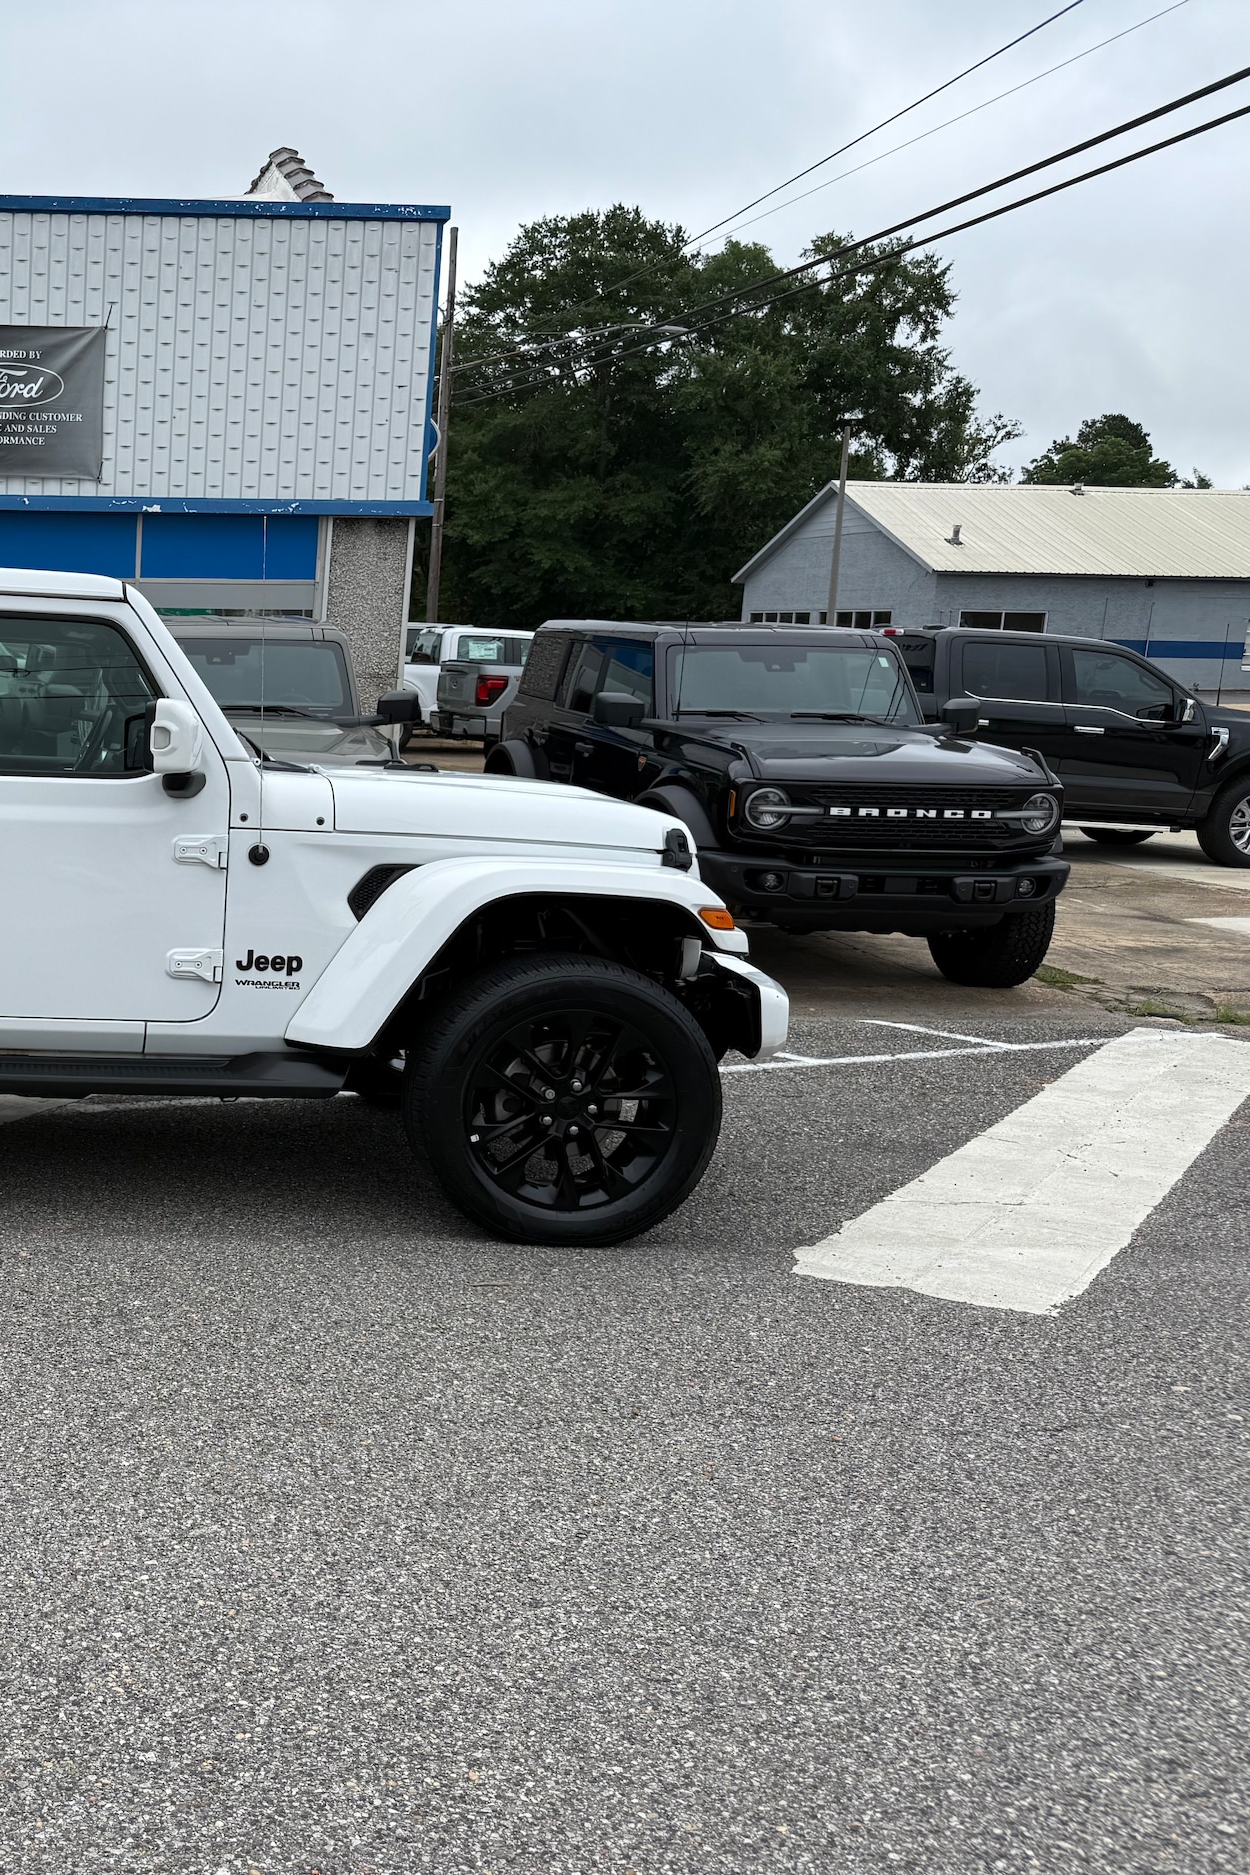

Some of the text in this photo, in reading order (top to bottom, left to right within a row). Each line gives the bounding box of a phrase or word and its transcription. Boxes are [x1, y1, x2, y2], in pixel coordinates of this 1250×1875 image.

[29, 350, 42, 360] BY
[28, 412, 83, 422] CUSTOMER
[4, 424, 25, 433] AND
[26, 424, 58, 434] SALES
[829, 807, 992, 819] BRONCO
[235, 949, 303, 976] Jeep
[235, 979, 300, 988] WRANGLER
